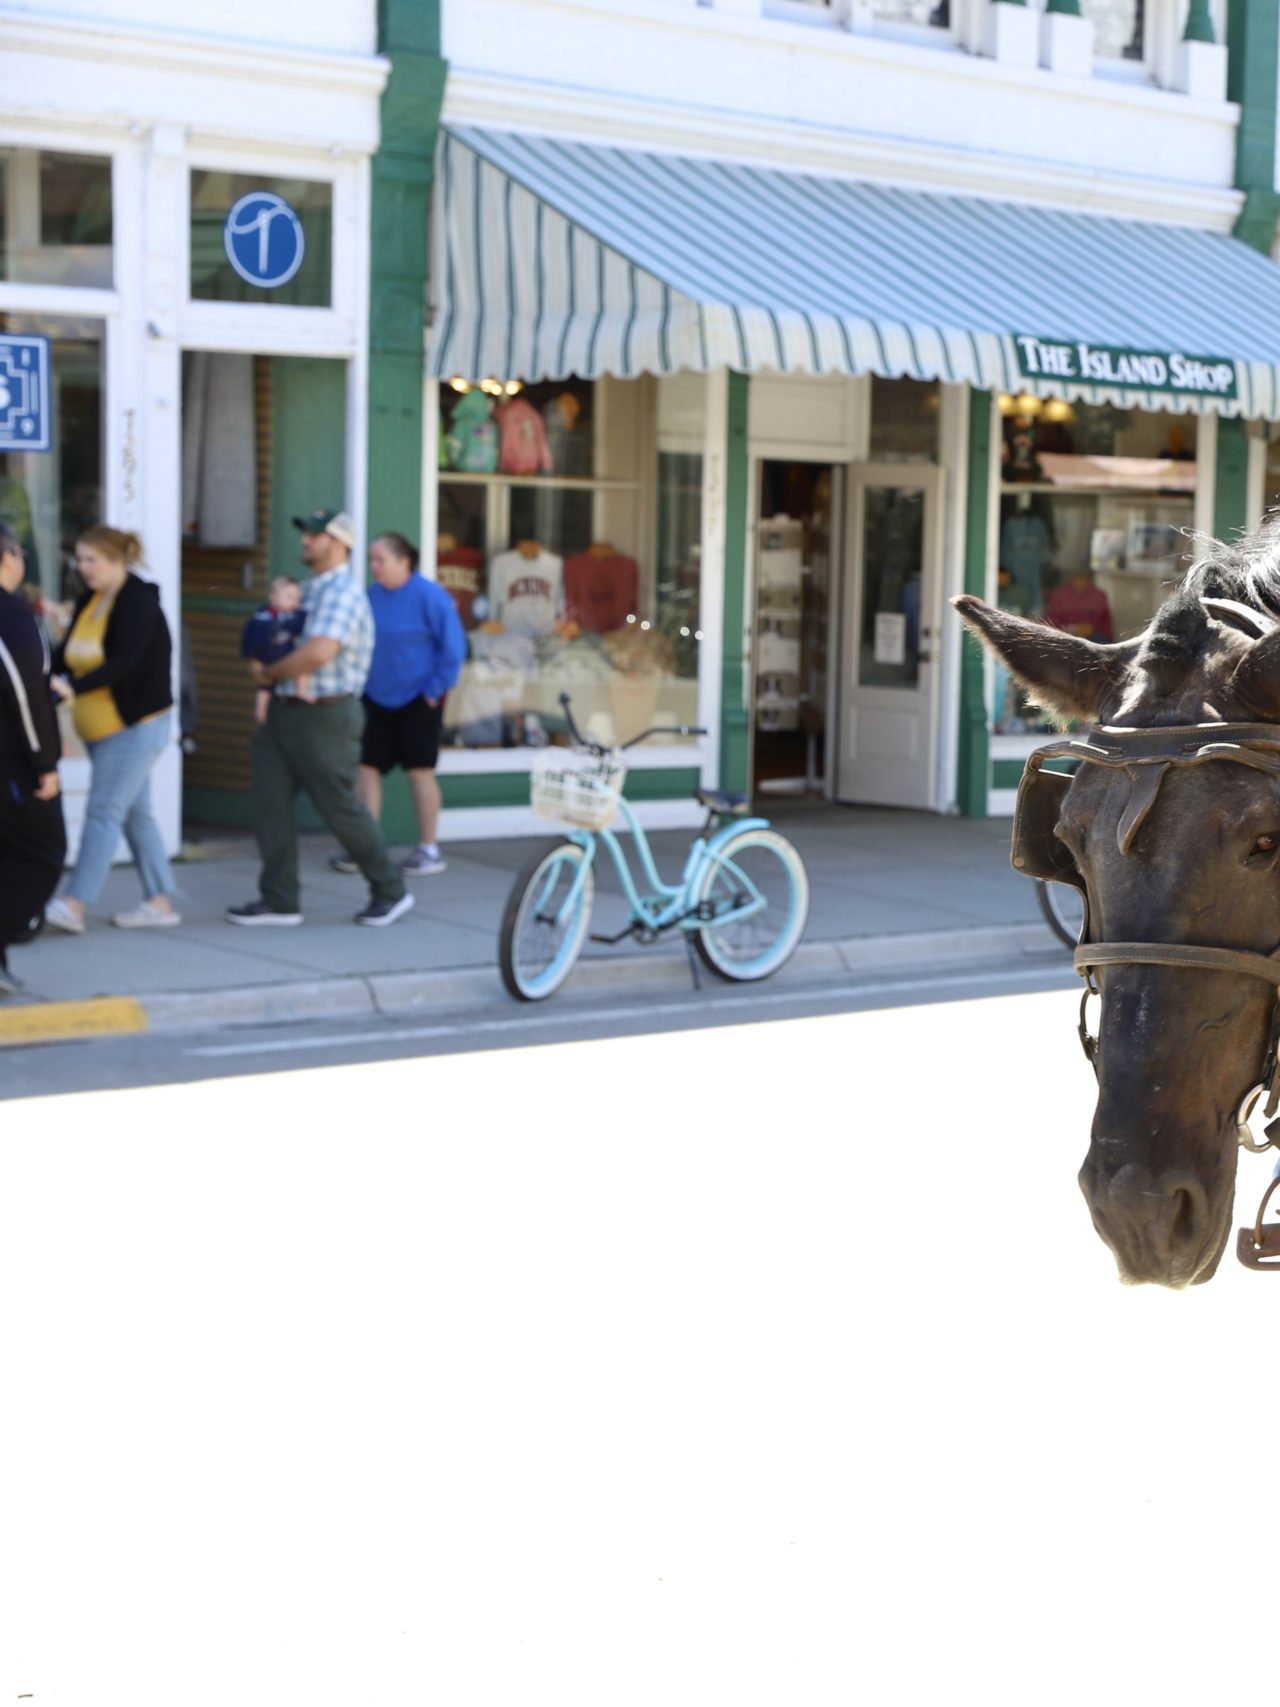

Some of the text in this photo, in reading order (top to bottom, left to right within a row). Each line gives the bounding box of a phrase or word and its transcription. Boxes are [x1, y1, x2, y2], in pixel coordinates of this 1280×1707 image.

[1017, 336, 1234, 393] THE ISLAND SHOP
